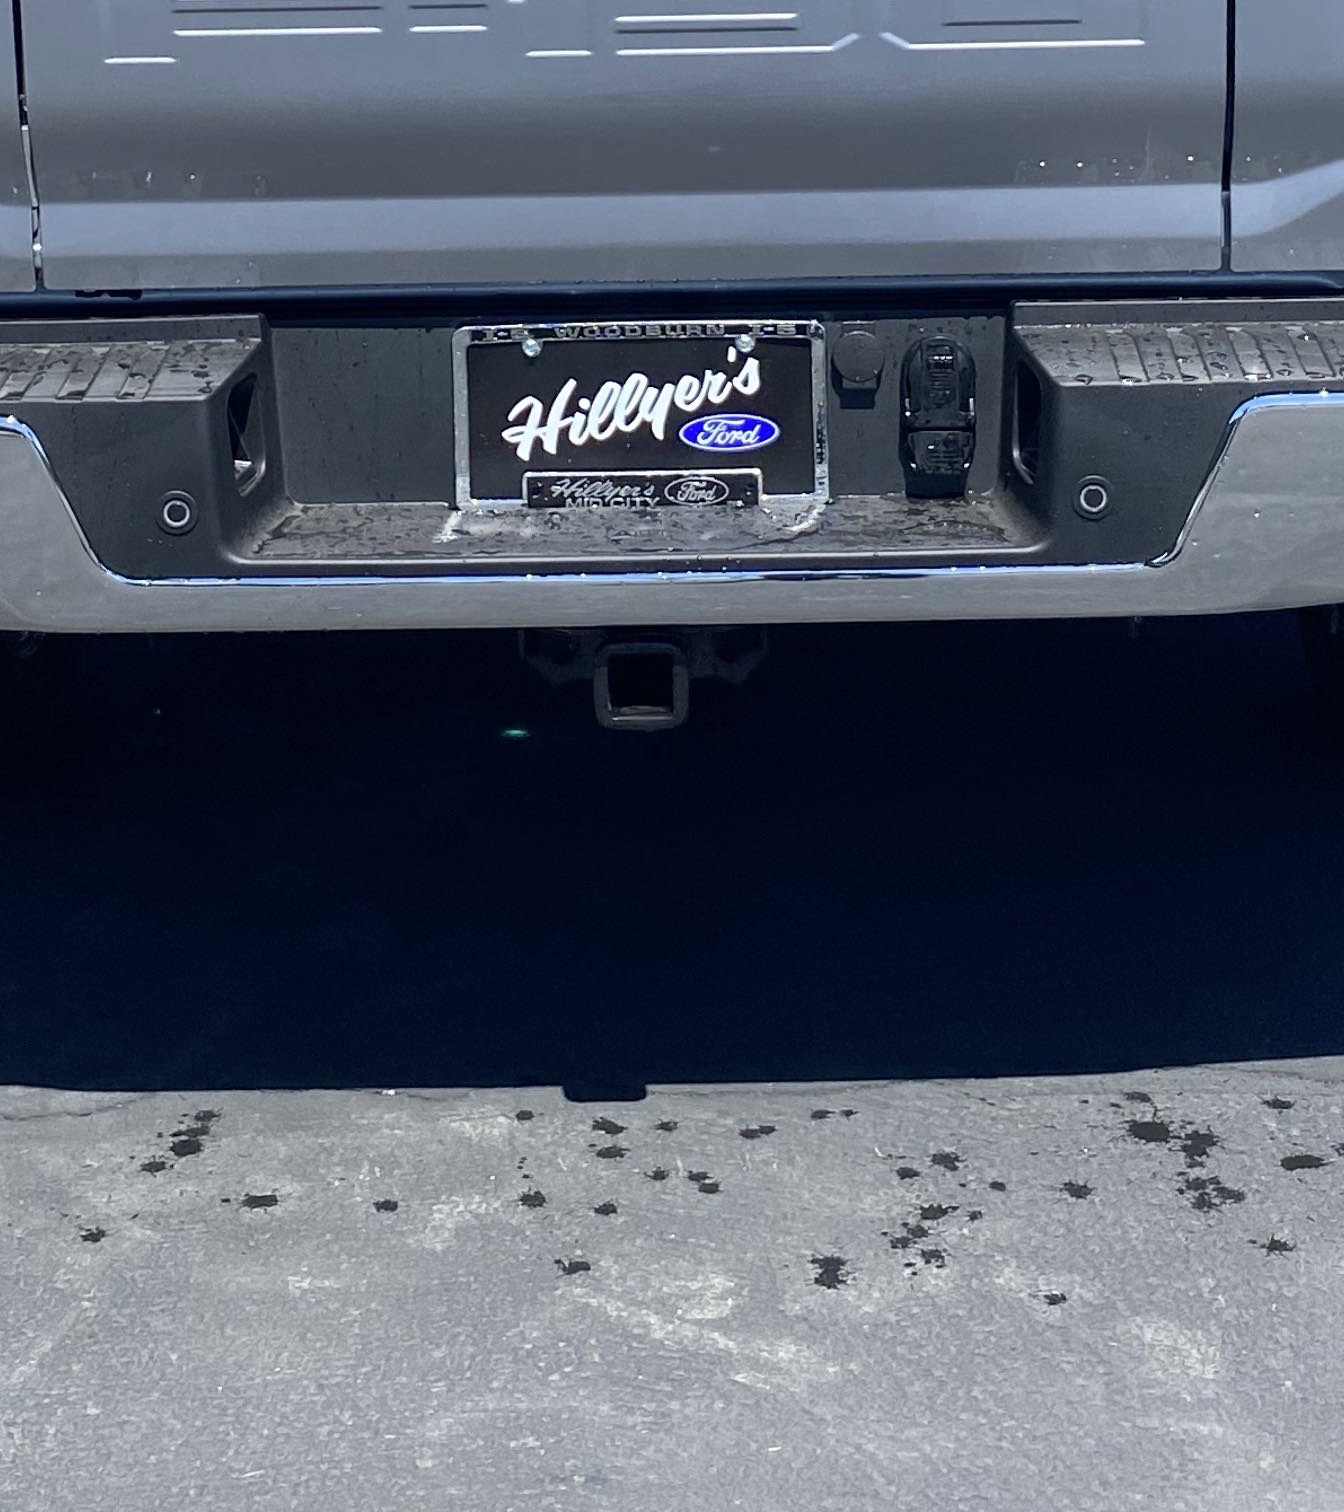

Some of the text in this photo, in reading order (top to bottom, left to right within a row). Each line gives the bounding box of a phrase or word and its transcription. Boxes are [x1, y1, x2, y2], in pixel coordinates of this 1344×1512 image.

[555, 323, 725, 338] WOODBURN
[501, 345, 761, 461] Hillyer's
[550, 477, 656, 501] Hillyer's
